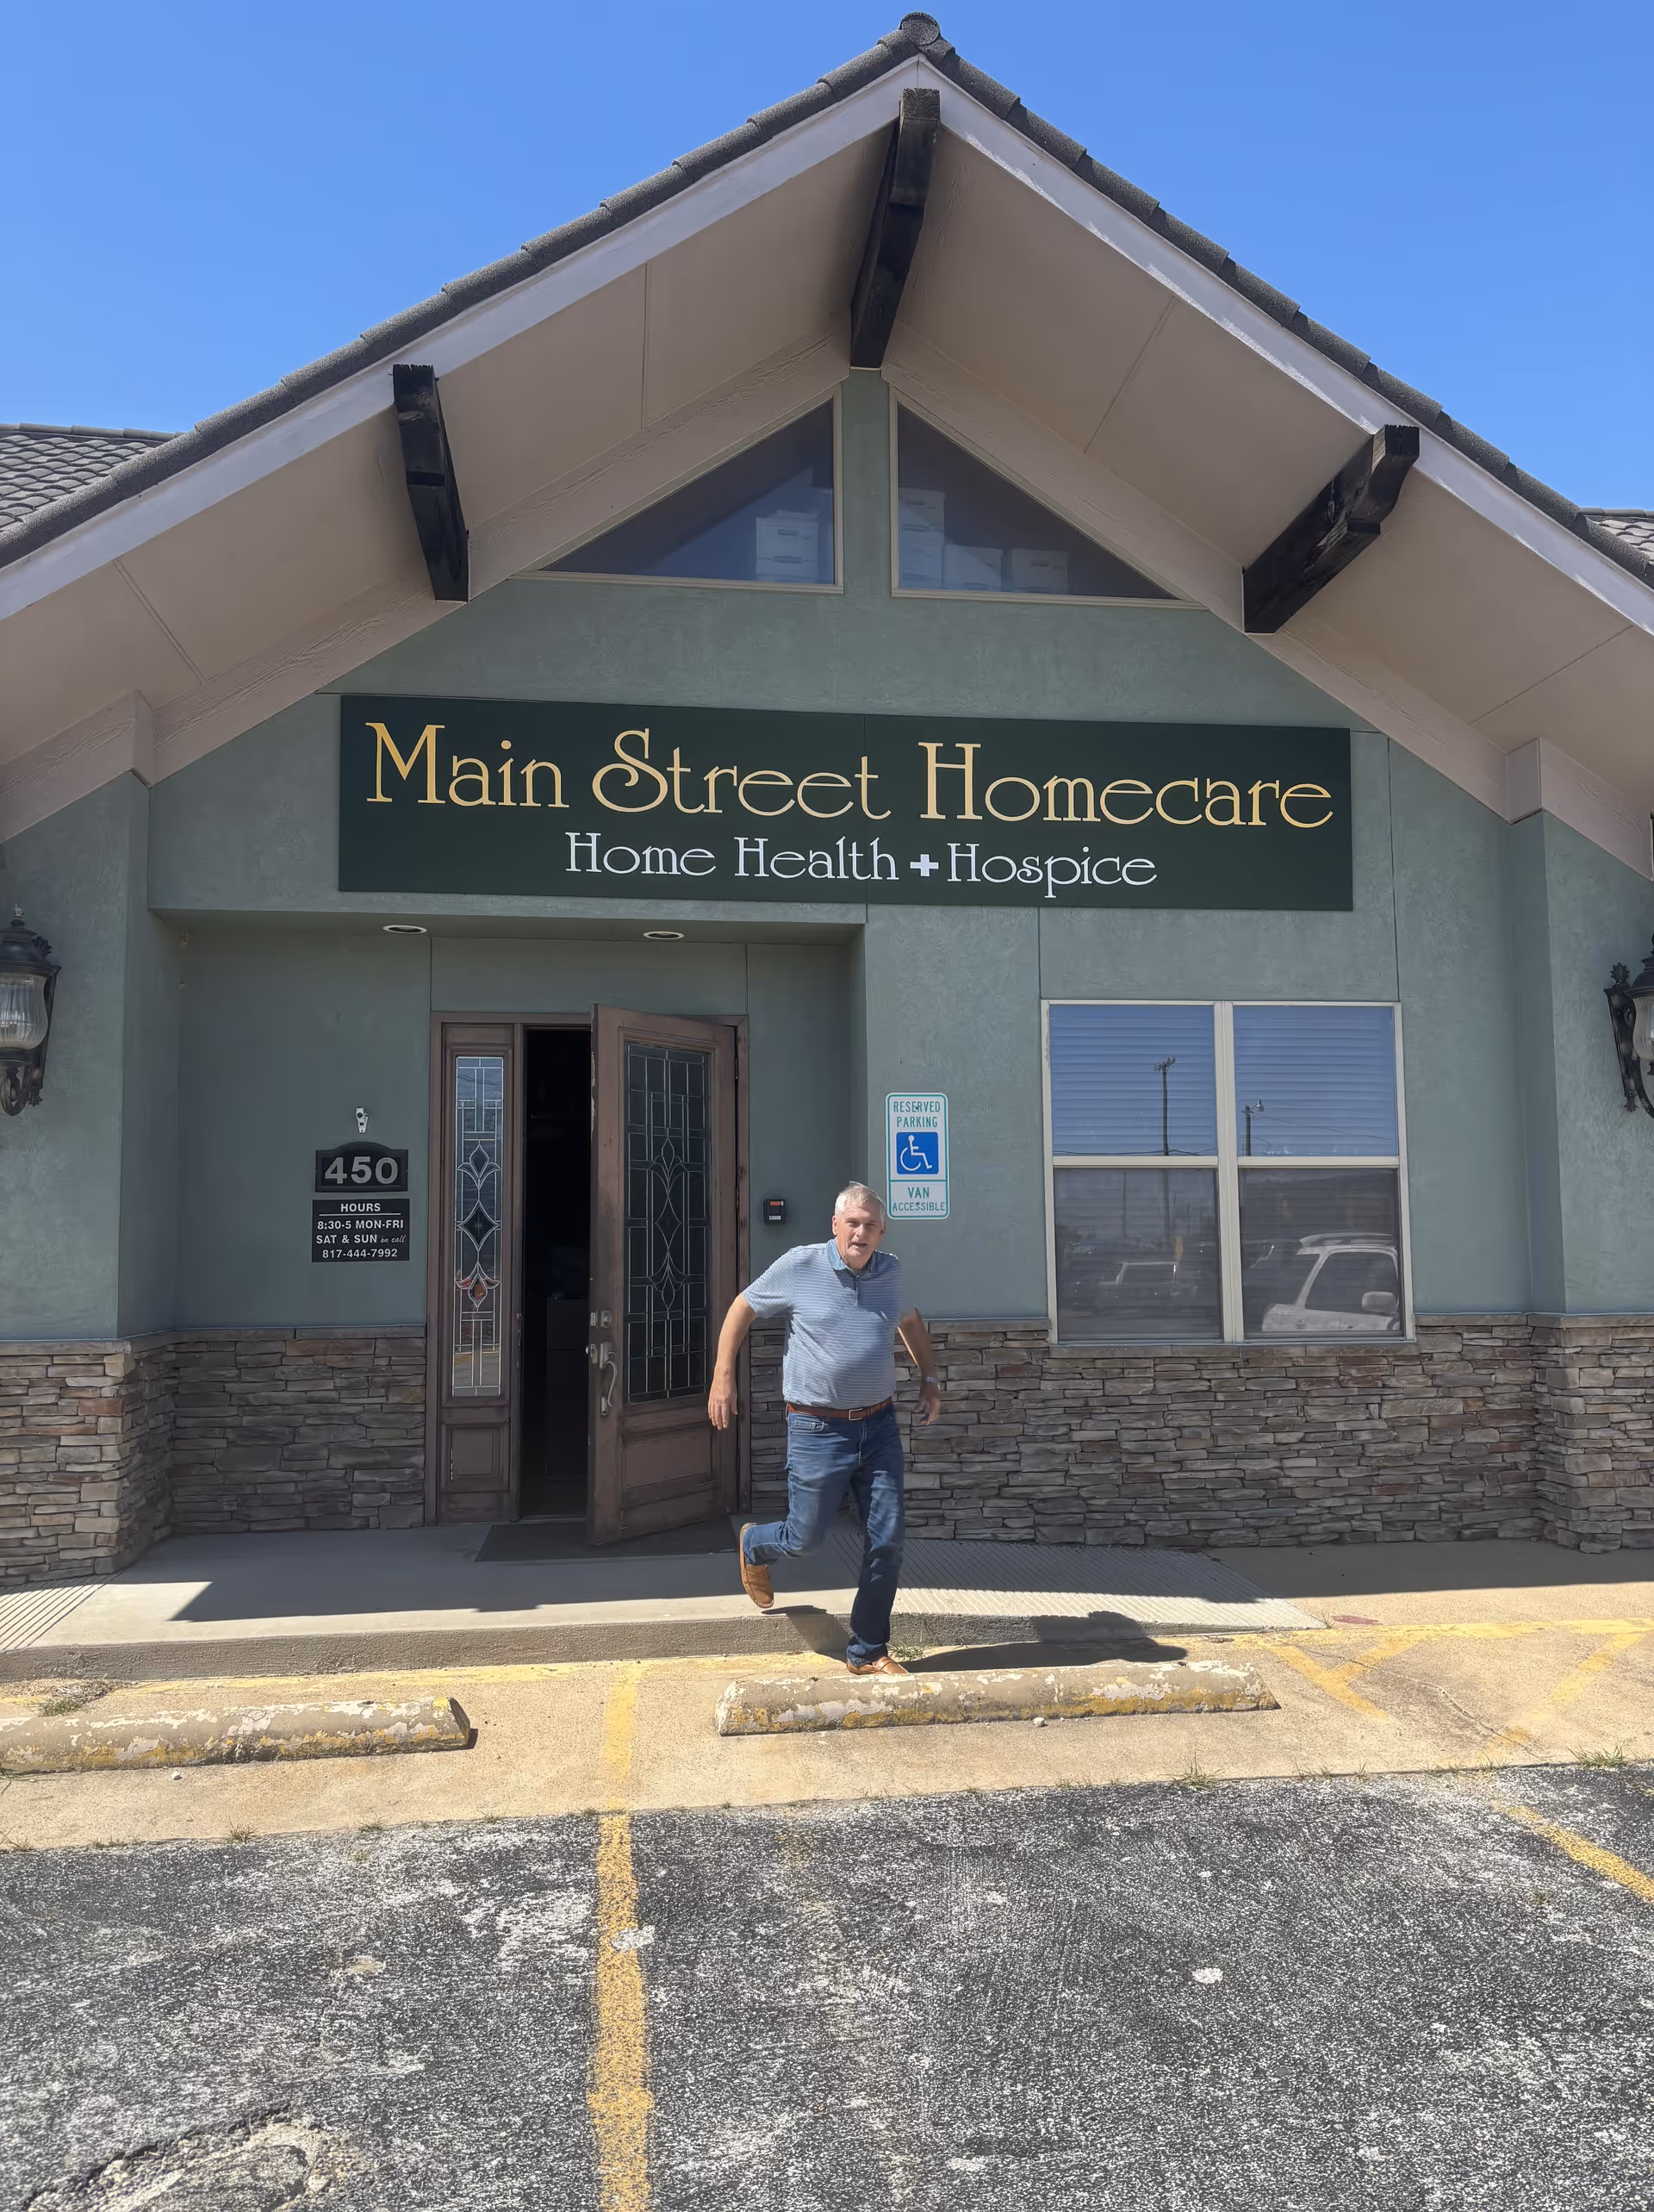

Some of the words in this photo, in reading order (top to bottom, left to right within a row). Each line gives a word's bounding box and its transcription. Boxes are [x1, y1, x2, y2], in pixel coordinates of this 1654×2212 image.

[365, 722, 570, 808] Main
[592, 727, 892, 820] Street
[917, 741, 1334, 828] Homecare
[564, 832, 717, 876] Home
[733, 835, 900, 881] Health
[946, 842, 1158, 899] Hospice
[893, 1101, 941, 1112] RESERVED
[897, 1116, 938, 1128] PARKING
[325, 1156, 398, 1184] 450
[907, 1187, 930, 1199] VAN
[340, 1202, 381, 1212] HOURS
[892, 1202, 945, 1212] ACCESSIBLE
[317, 1220, 351, 1231] 8:30-5
[355, 1219, 404, 1230] MON-FRI
[316, 1234, 337, 1244] SAT
[341, 1234, 350, 1244] &
[354, 1234, 377, 1243] SUN
[391, 1234, 407, 1243] call
[322, 1248, 398, 1259] 817-444-7992
